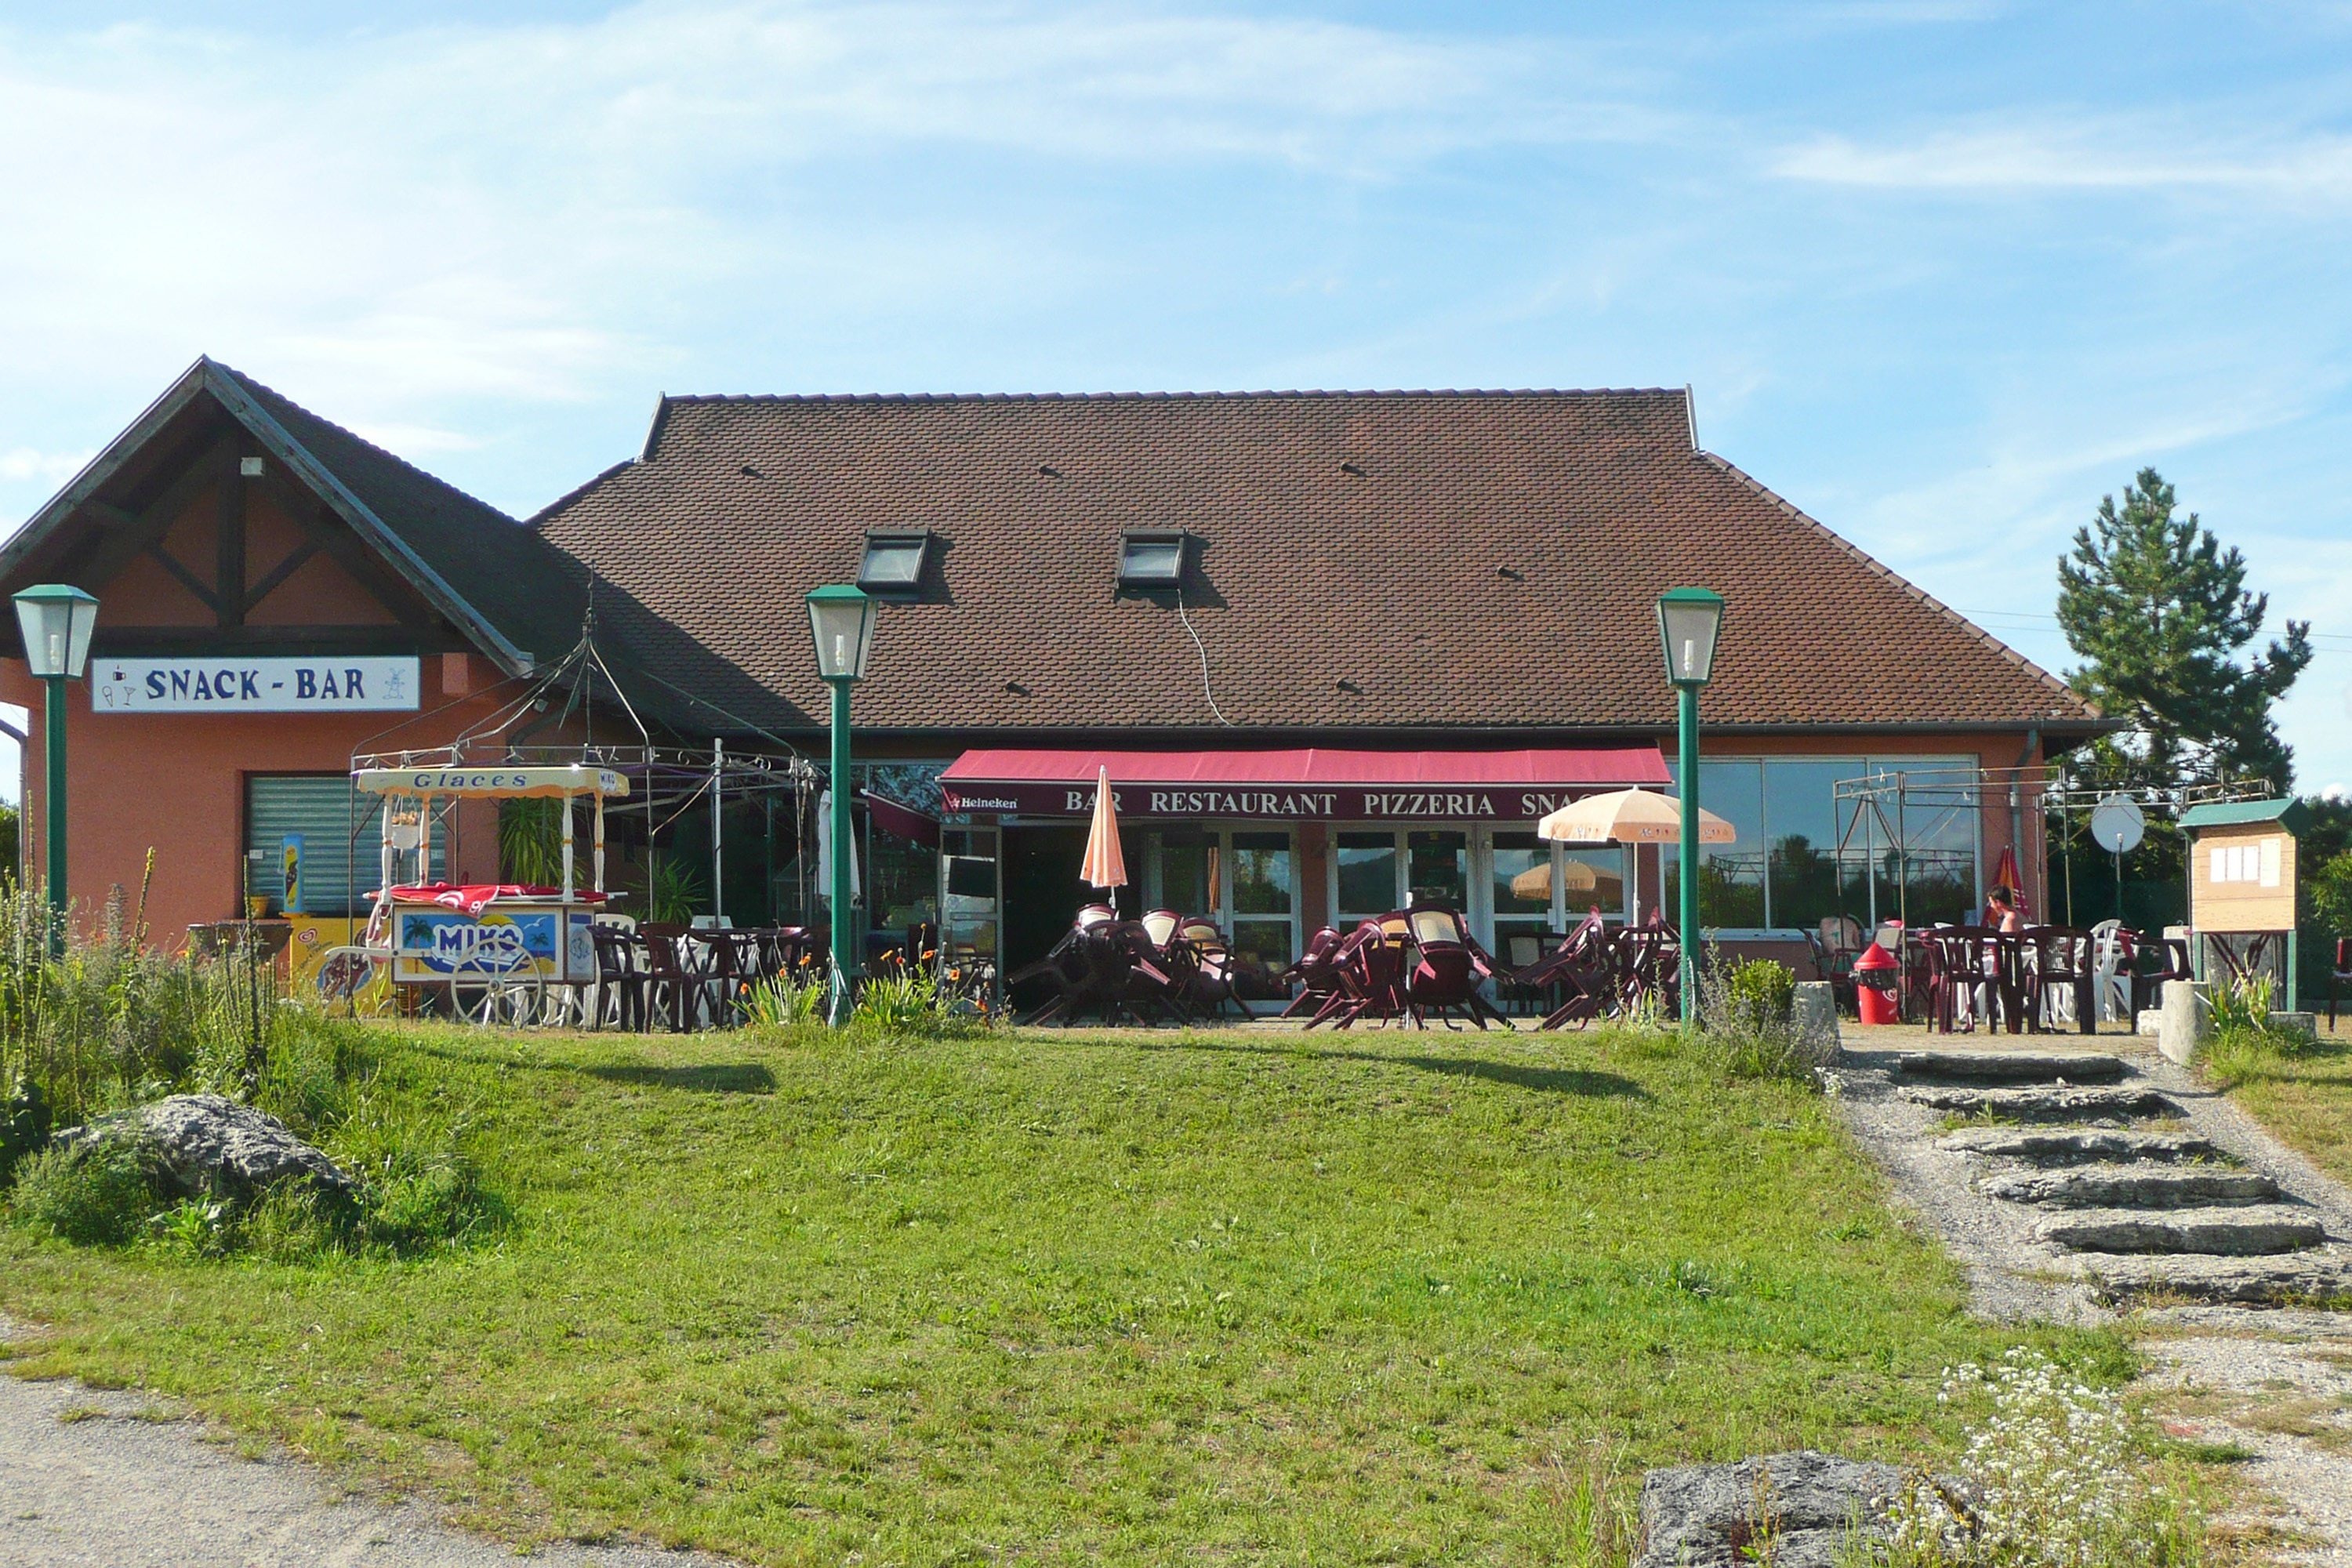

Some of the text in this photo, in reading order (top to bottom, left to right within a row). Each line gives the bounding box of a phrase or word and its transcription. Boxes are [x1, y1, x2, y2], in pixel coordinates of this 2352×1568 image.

[146, 669, 261, 700] SNACK
[295, 669, 365, 700] BAR
[414, 773, 528, 788] Glaces
[600, 772, 615, 784] MIKO
[961, 797, 1018, 809] Heineken
[1150, 792, 1337, 815] RESTAURANT
[1363, 793, 1496, 815] PIZZERIA
[438, 927, 521, 952] MIKO
